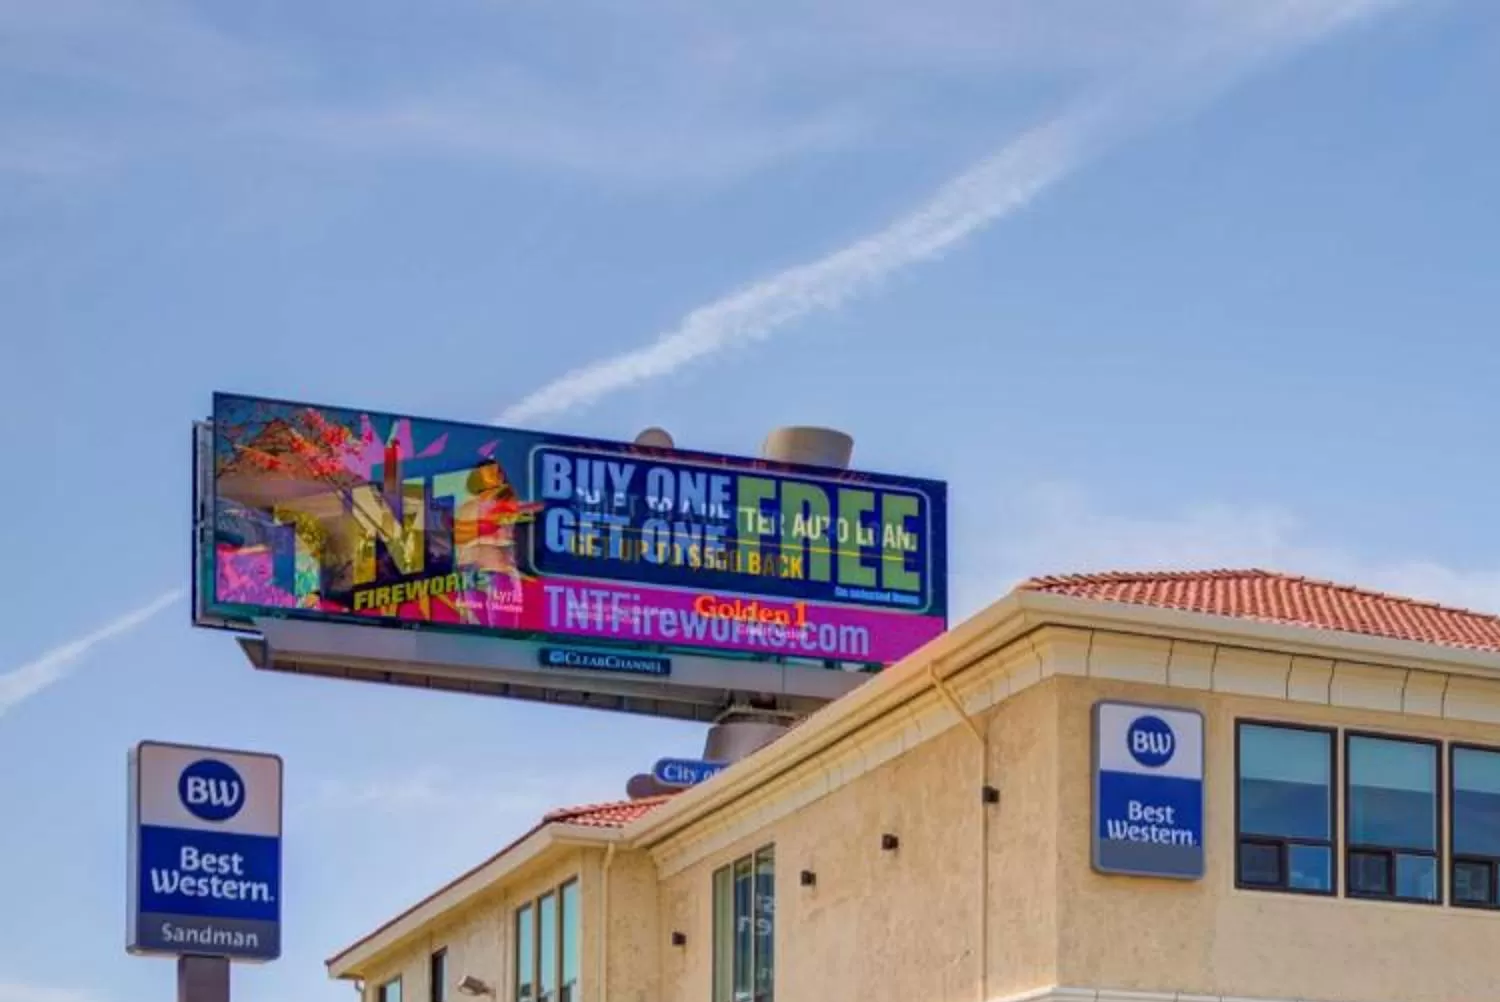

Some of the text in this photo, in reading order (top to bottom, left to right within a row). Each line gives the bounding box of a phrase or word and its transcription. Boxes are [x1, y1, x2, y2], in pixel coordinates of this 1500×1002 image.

[542, 453, 636, 506] BUY
[647, 466, 732, 518] ONE
[545, 507, 631, 560] GET
[641, 518, 728, 568] ONE
[736, 475, 921, 591] FREE
[694, 594, 790, 626] Golden
[1132, 730, 1172, 756] BW
[186, 775, 240, 808] BW
[1127, 799, 1175, 825] Best
[179, 846, 244, 876] Best
[161, 922, 259, 948] Sandman
